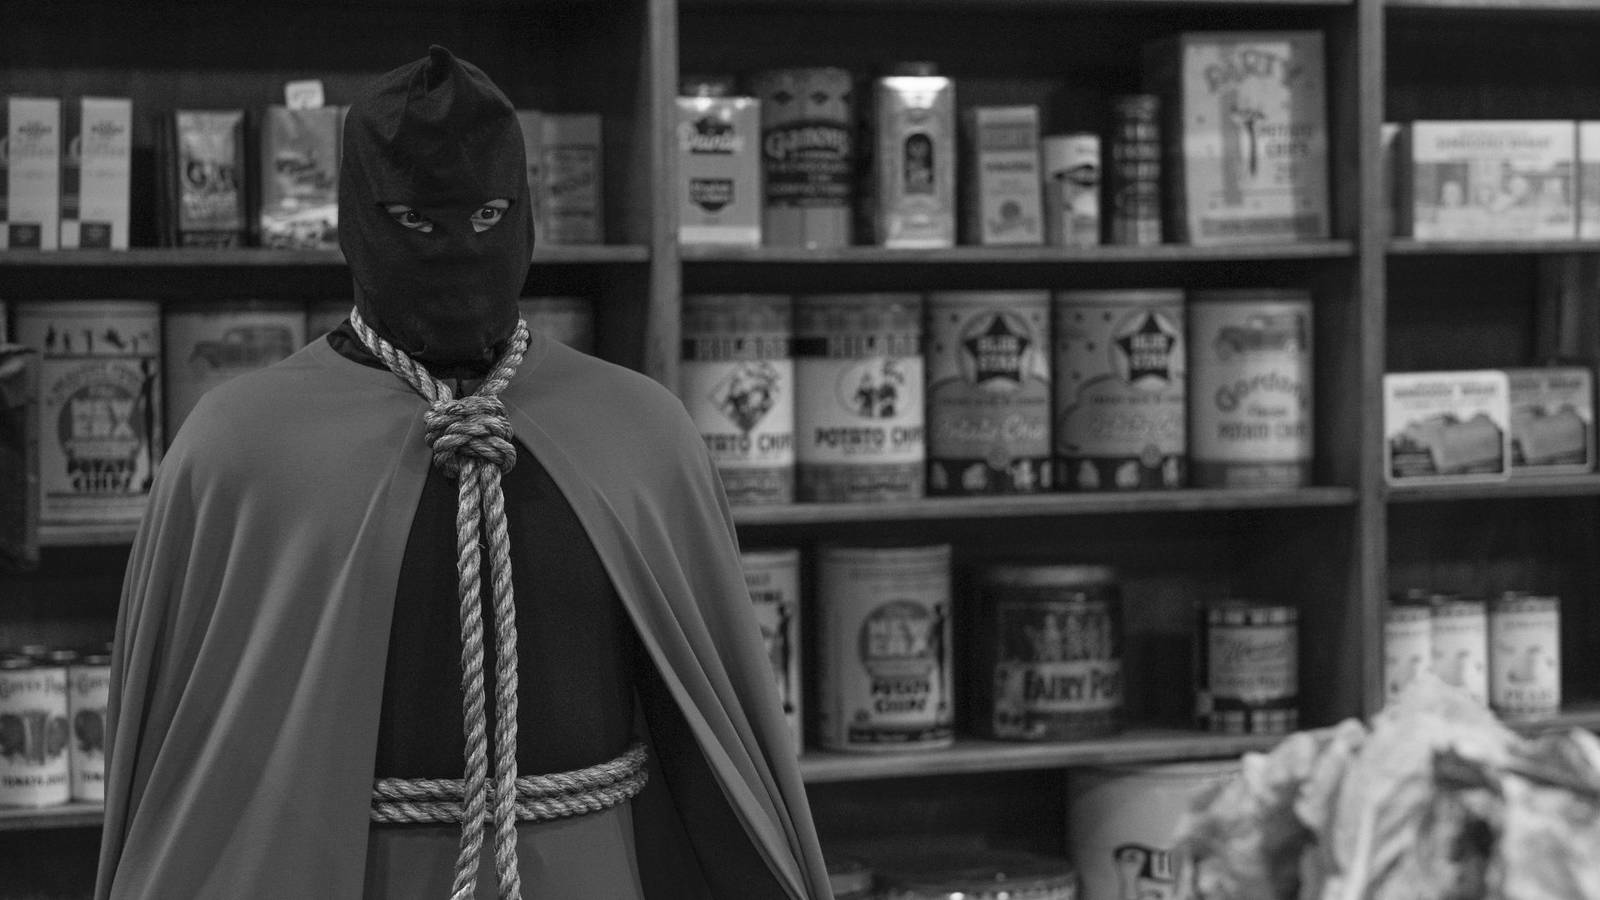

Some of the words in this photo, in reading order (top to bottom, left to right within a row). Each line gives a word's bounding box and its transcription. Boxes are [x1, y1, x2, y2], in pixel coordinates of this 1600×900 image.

[977, 334, 1018, 351] BLUE
[1129, 334, 1168, 351] BLUE
[979, 354, 1018, 371] STAR
[1131, 353, 1169, 371] STAR
[701, 433, 752, 451] TATO
[756, 432, 792, 451] CHIP
[814, 427, 886, 447] POTATO
[890, 426, 924, 446] CHIP
[67, 458, 138, 475] POTATO
[72, 474, 133, 492] CHIPS
[1024, 671, 1085, 701] FAIRY
